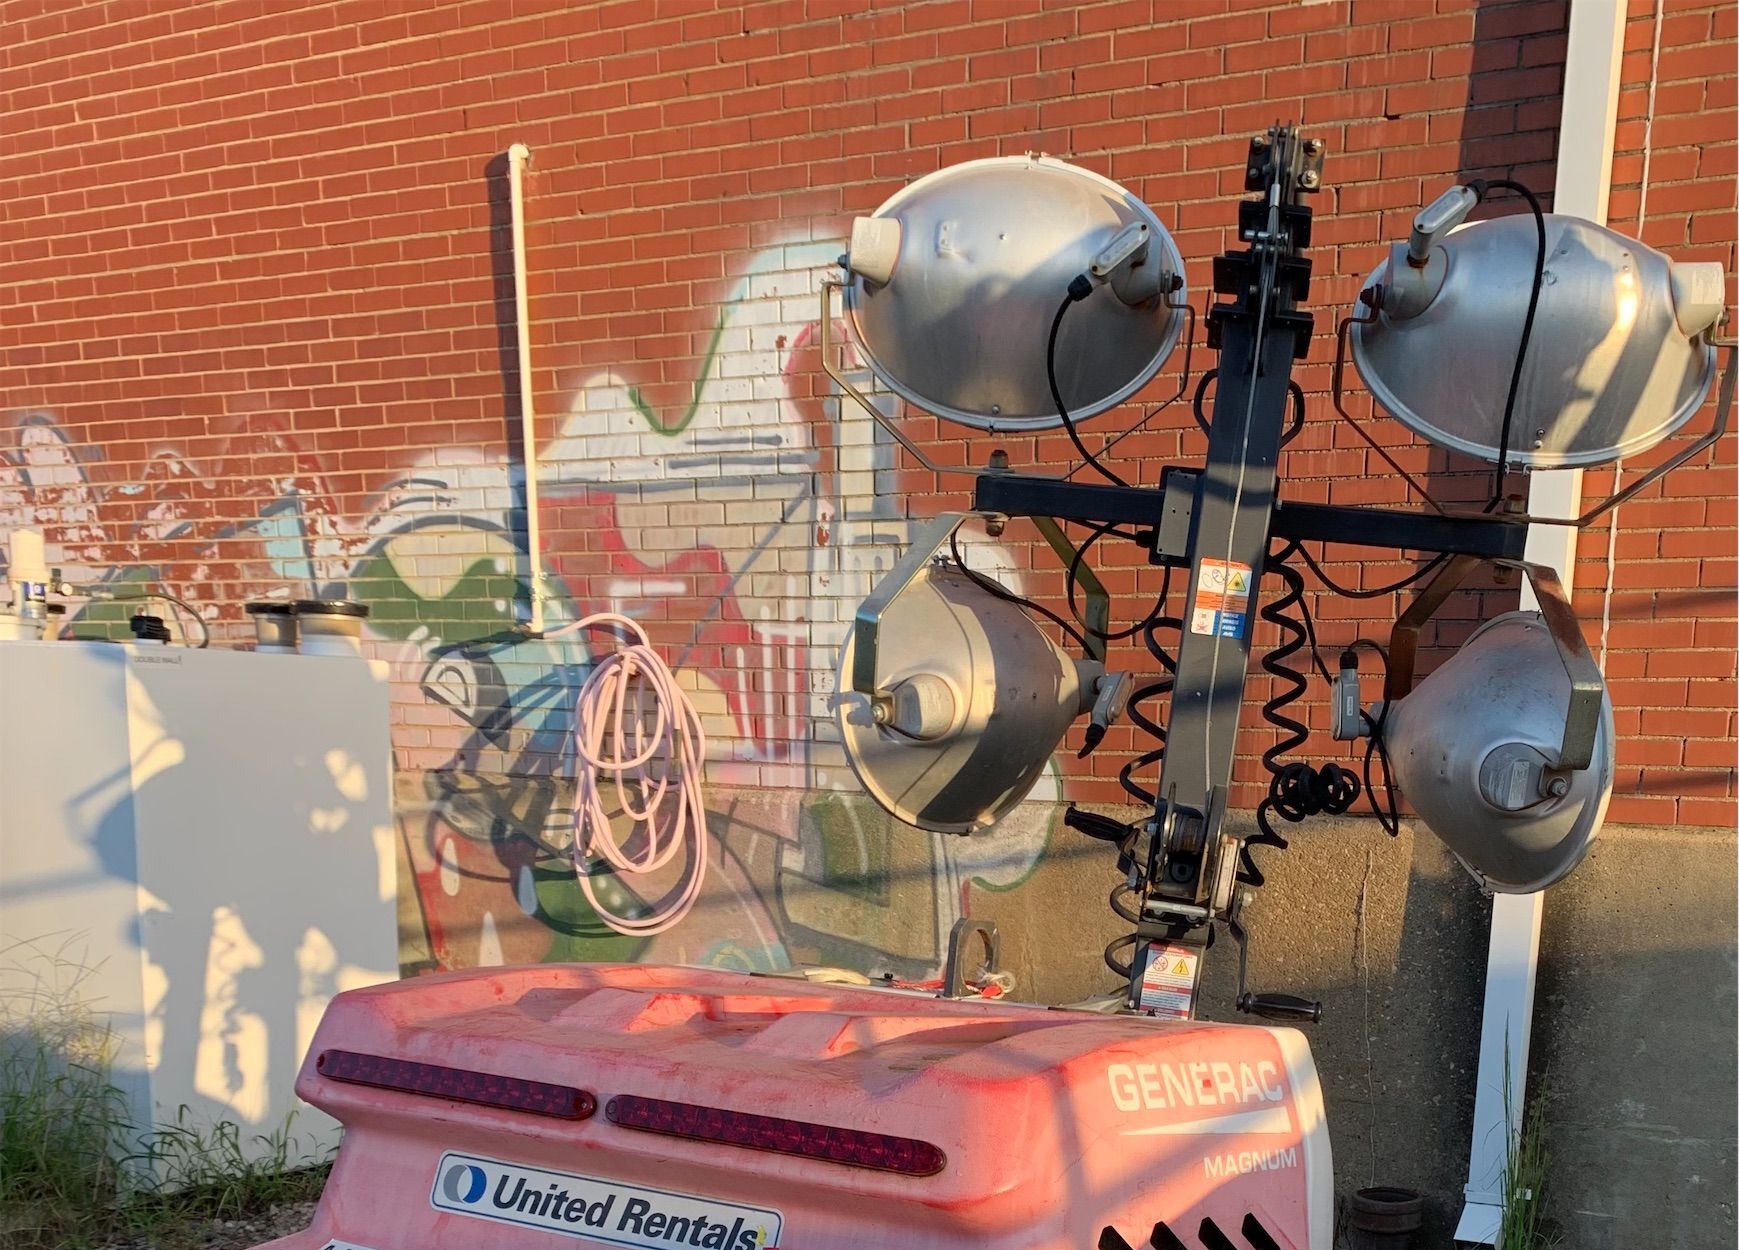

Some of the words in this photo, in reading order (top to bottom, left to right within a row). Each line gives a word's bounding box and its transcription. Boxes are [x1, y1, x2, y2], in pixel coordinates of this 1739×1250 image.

[1107, 1061, 1283, 1112] GENERAC
[1203, 1148, 1297, 1178] MAGNUM
[492, 1174, 616, 1229] United
